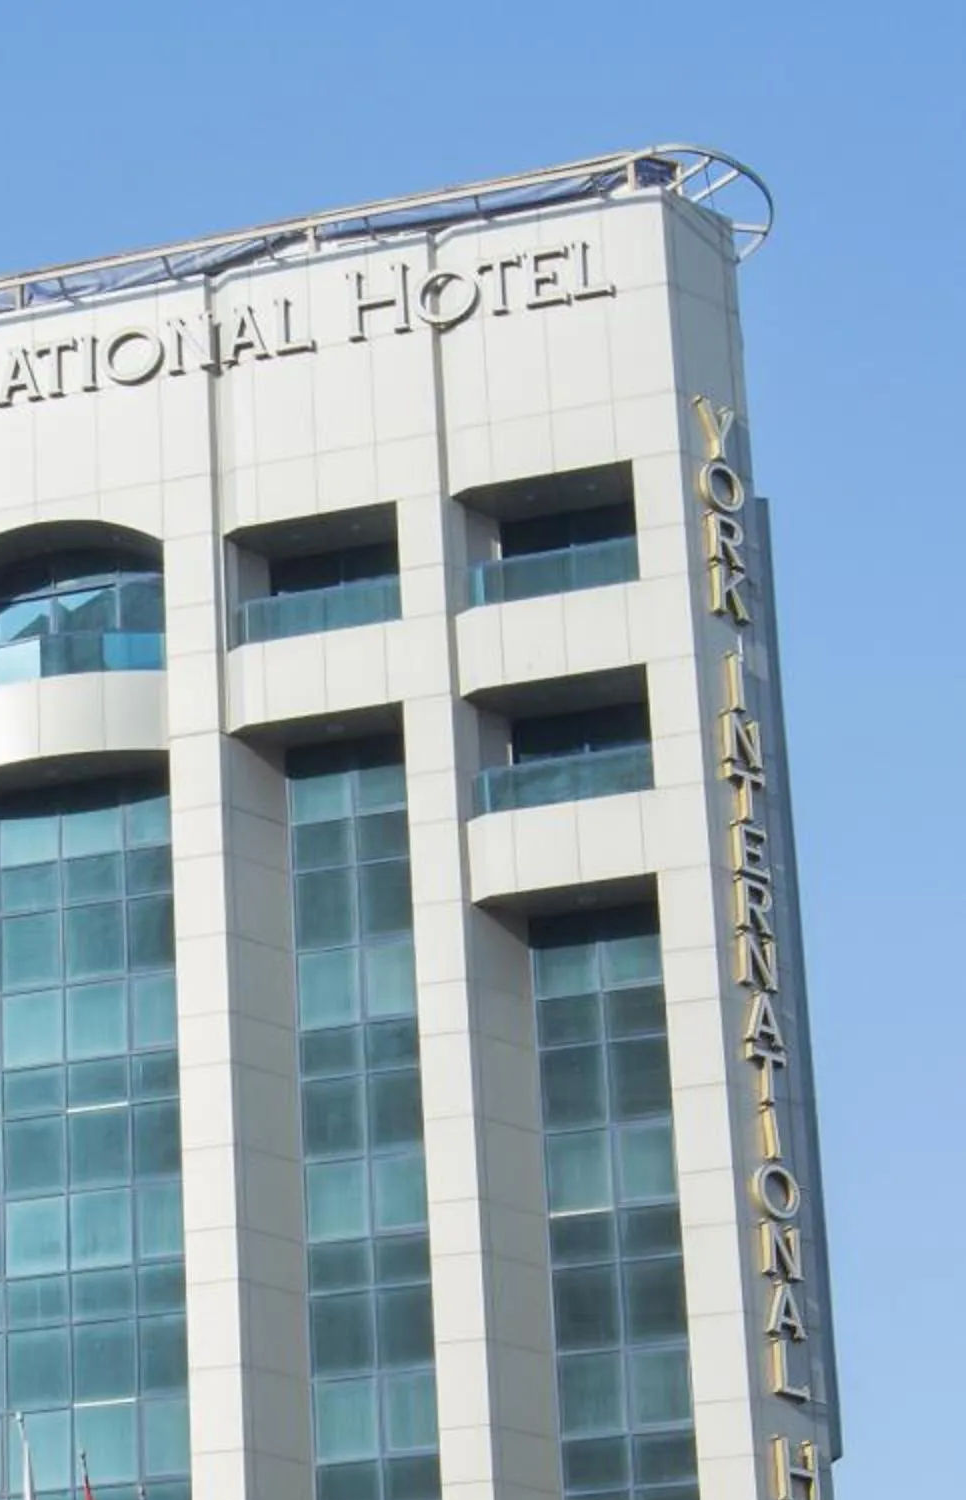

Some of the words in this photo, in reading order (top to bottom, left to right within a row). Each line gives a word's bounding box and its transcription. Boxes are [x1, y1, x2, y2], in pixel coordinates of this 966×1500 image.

[345, 239, 616, 344] HOTEL
[690, 393, 752, 627] YORK
[719, 648, 811, 1402] INTERNATIONAL
